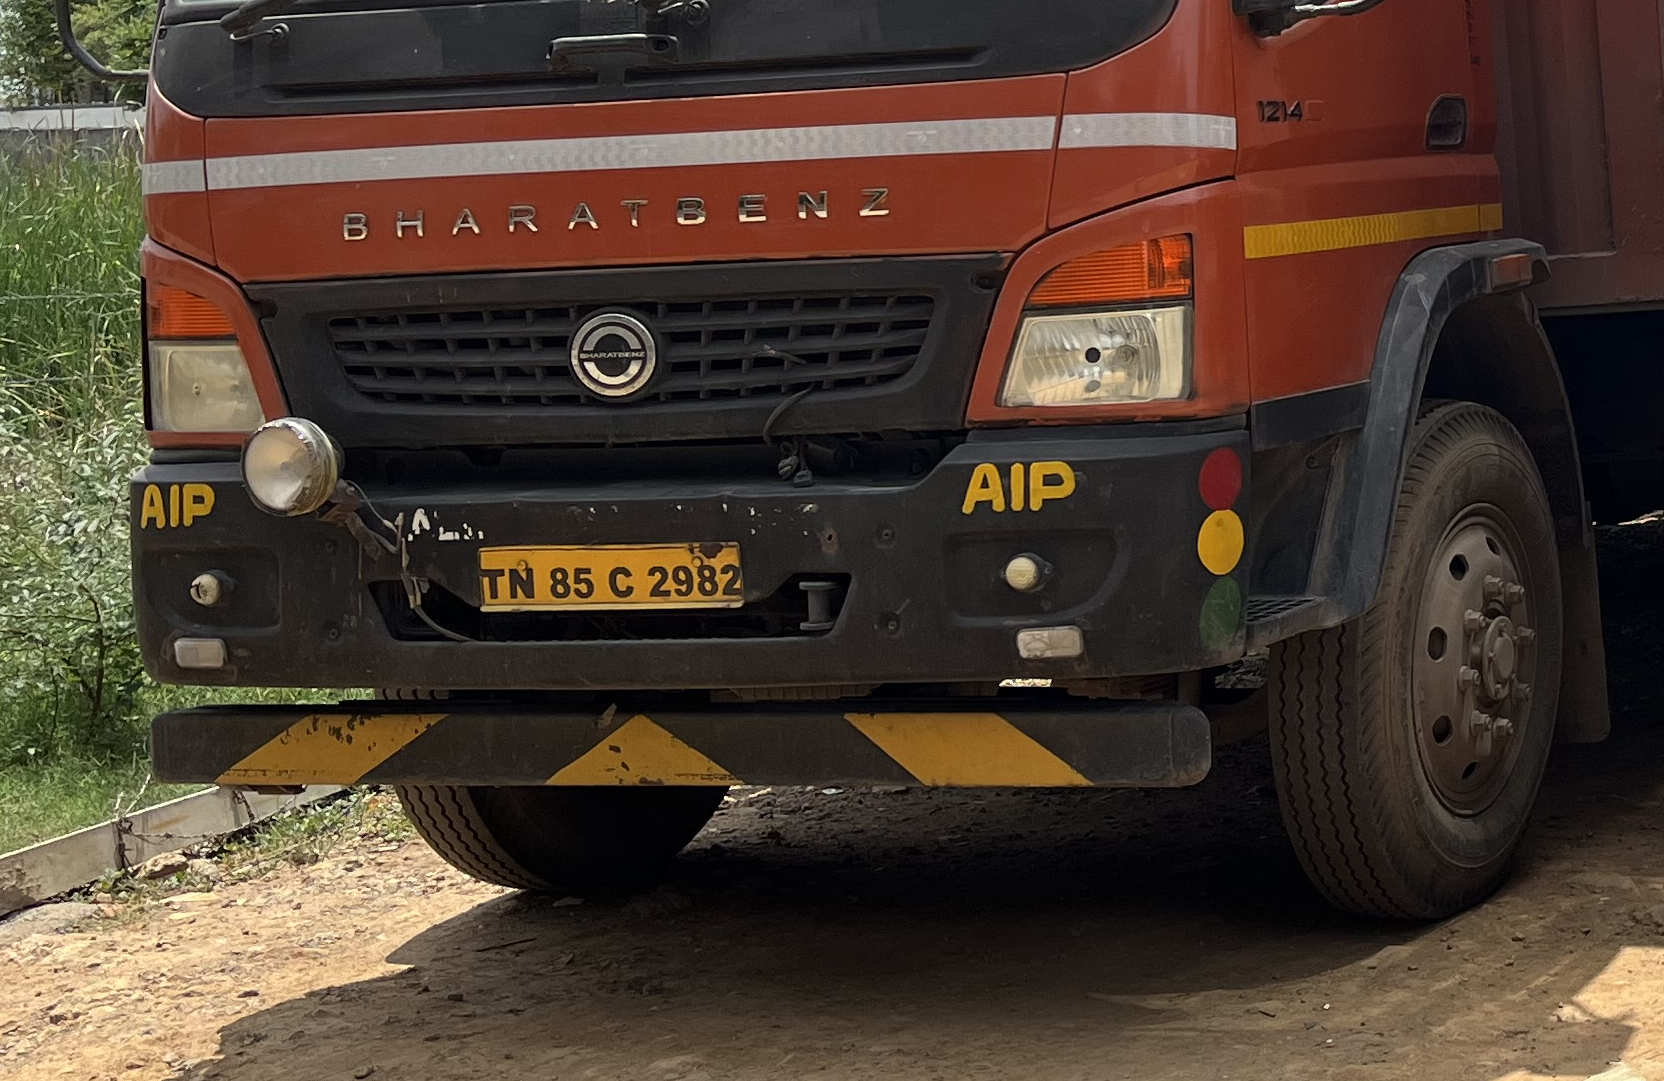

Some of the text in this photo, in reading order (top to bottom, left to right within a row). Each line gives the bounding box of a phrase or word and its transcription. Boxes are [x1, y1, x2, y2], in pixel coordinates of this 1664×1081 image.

[1256, 99, 1303, 123] 1214
[342, 186, 890, 242] BHARATBENZ
[579, 351, 646, 360] BHARATBENZ
[140, 483, 216, 529] AIP
[962, 460, 1077, 515] AIP
[481, 561, 742, 601] TN 85 C 2982
